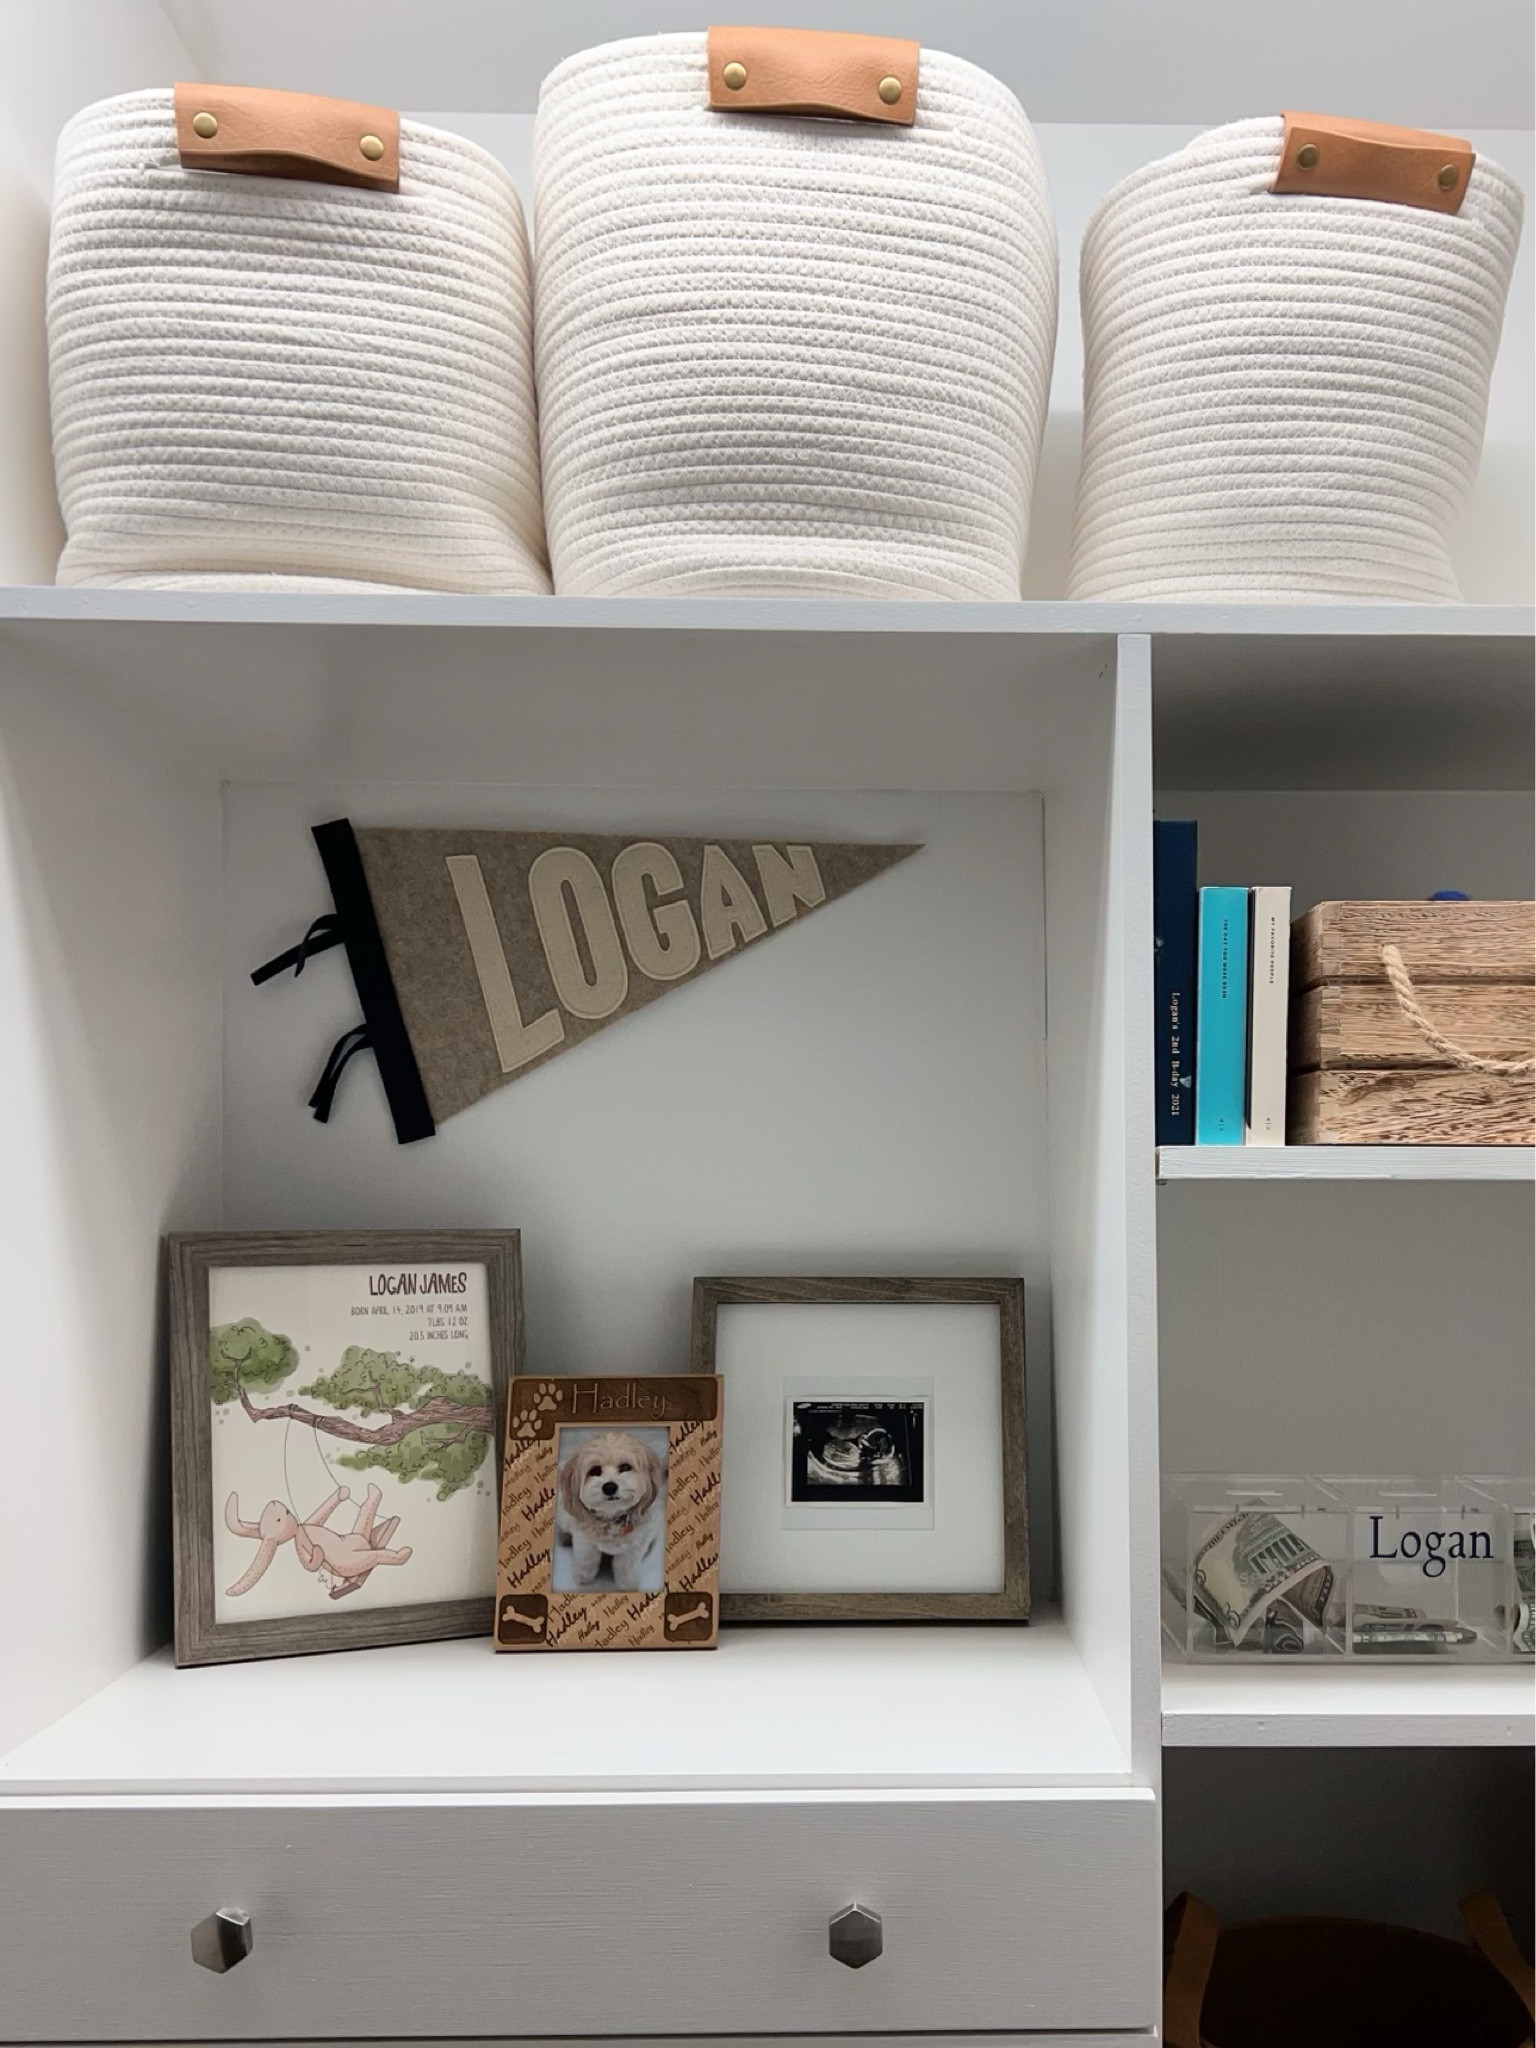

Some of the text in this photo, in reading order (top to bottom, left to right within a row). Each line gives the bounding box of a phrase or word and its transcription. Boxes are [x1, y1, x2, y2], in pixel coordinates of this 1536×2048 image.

[445, 841, 827, 1073] LOGAN
[1170, 992, 1181, 1116] Logan's 2nd B-day 2021
[368, 1271, 468, 1296] LOGAN JAMES
[350, 1306, 369, 1316] BORN
[371, 1306, 390, 1316] APRIL
[405, 1304, 424, 1315] 2019
[426, 1303, 435, 1314] AT
[572, 1382, 666, 1420] Hadley
[1369, 1515, 1495, 1578] Logan
[506, 1548, 552, 1590] Hadley
[545, 1606, 588, 1648] Hadley
